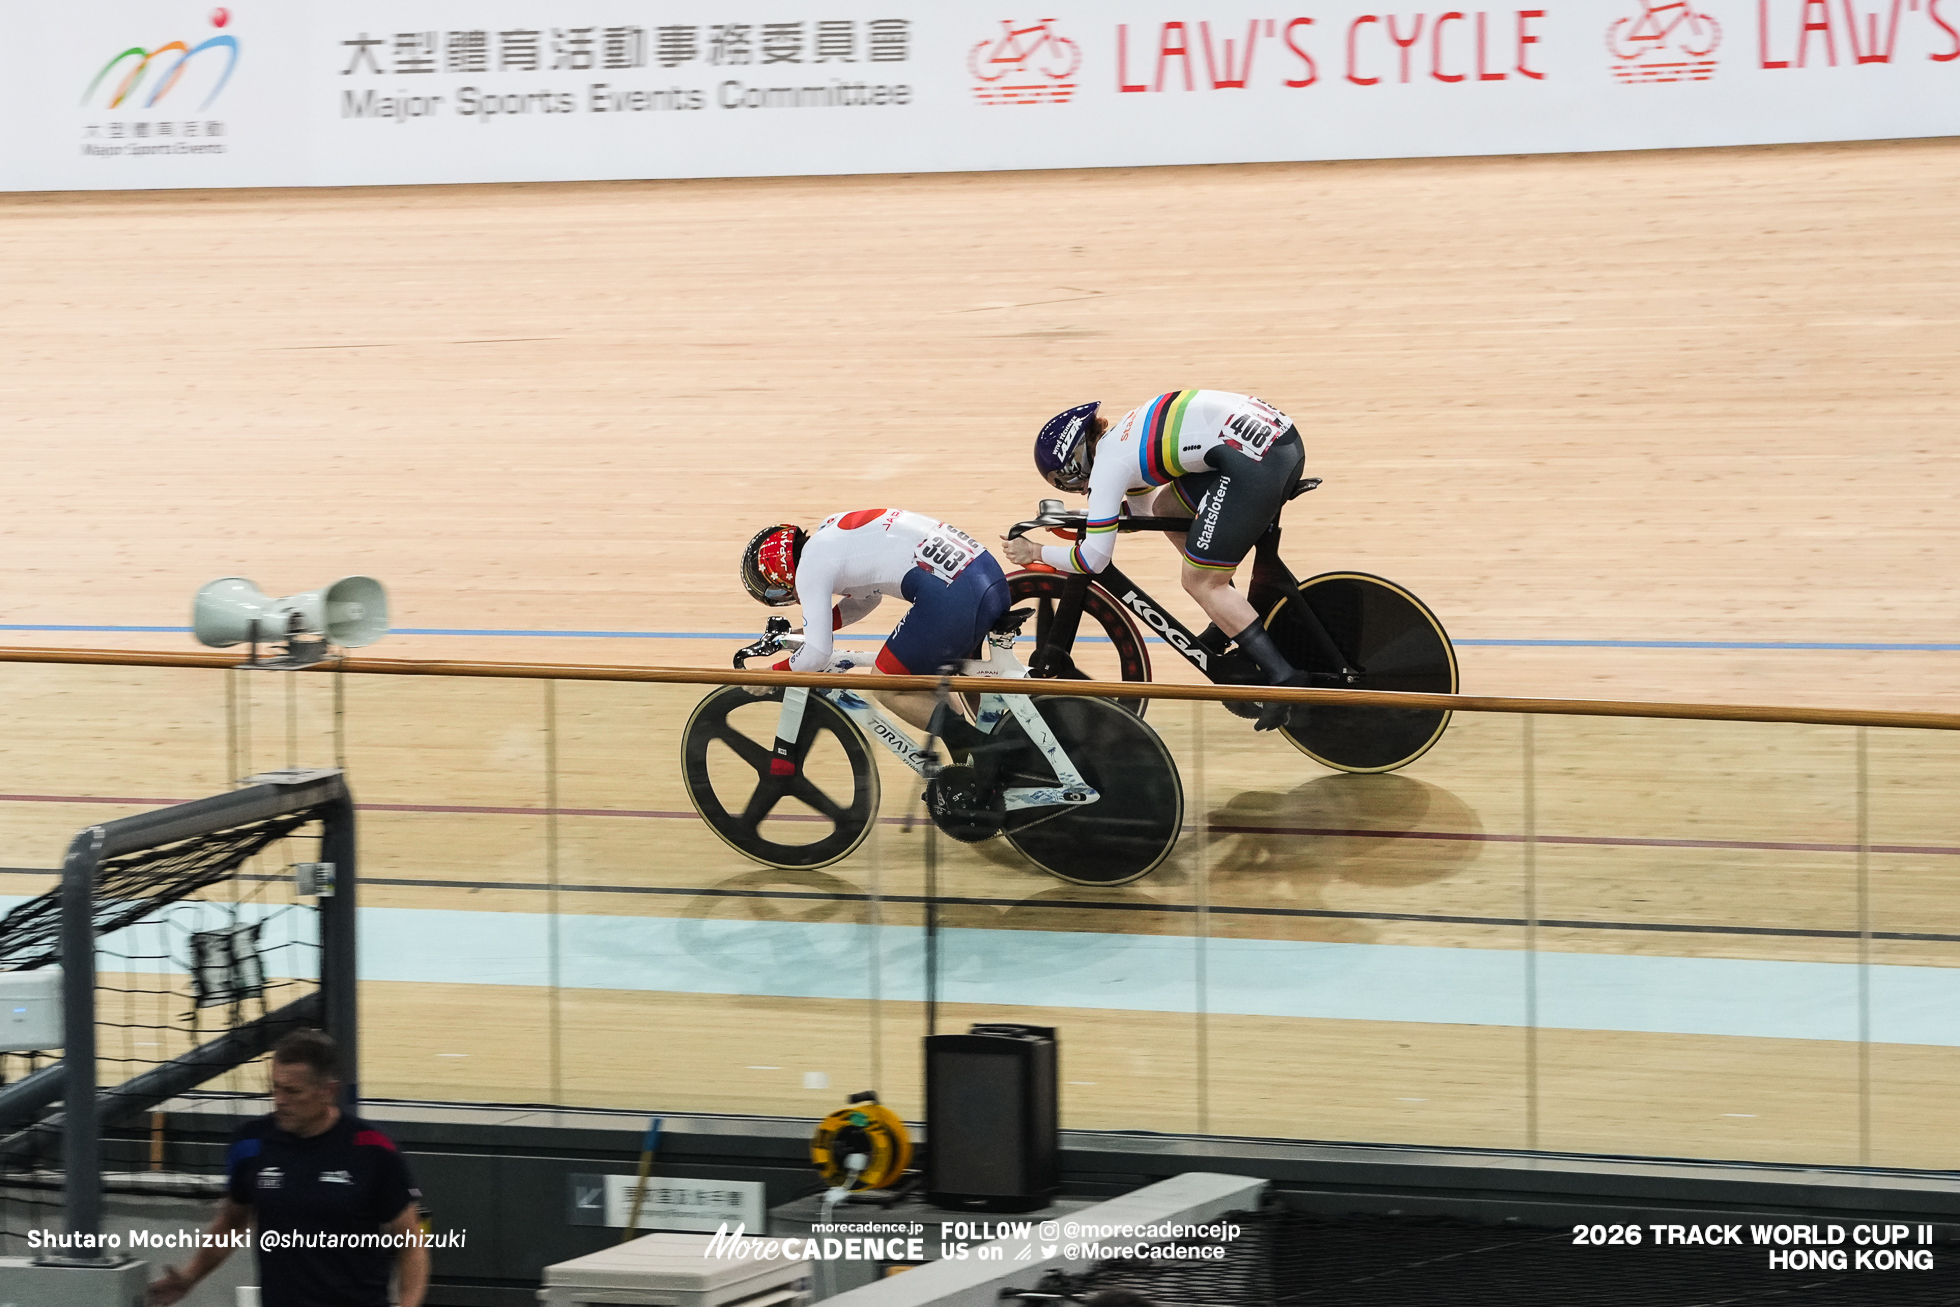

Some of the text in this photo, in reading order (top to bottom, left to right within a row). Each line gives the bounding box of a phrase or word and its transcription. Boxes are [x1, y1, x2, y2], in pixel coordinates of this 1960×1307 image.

[339, 19, 912, 76] 大型體育活動事務委員會
[1117, 10, 1547, 93] LAW'S CYCLE
[342, 78, 913, 124] Major Sports Events Committee
[1057, 417, 1083, 463] LAZER
[1229, 413, 1273, 448] 408
[1196, 475, 1231, 551] Staatsloterij
[780, 531, 789, 572] JAPAN
[922, 536, 966, 571] 393
[1121, 590, 1208, 672] KOGA
